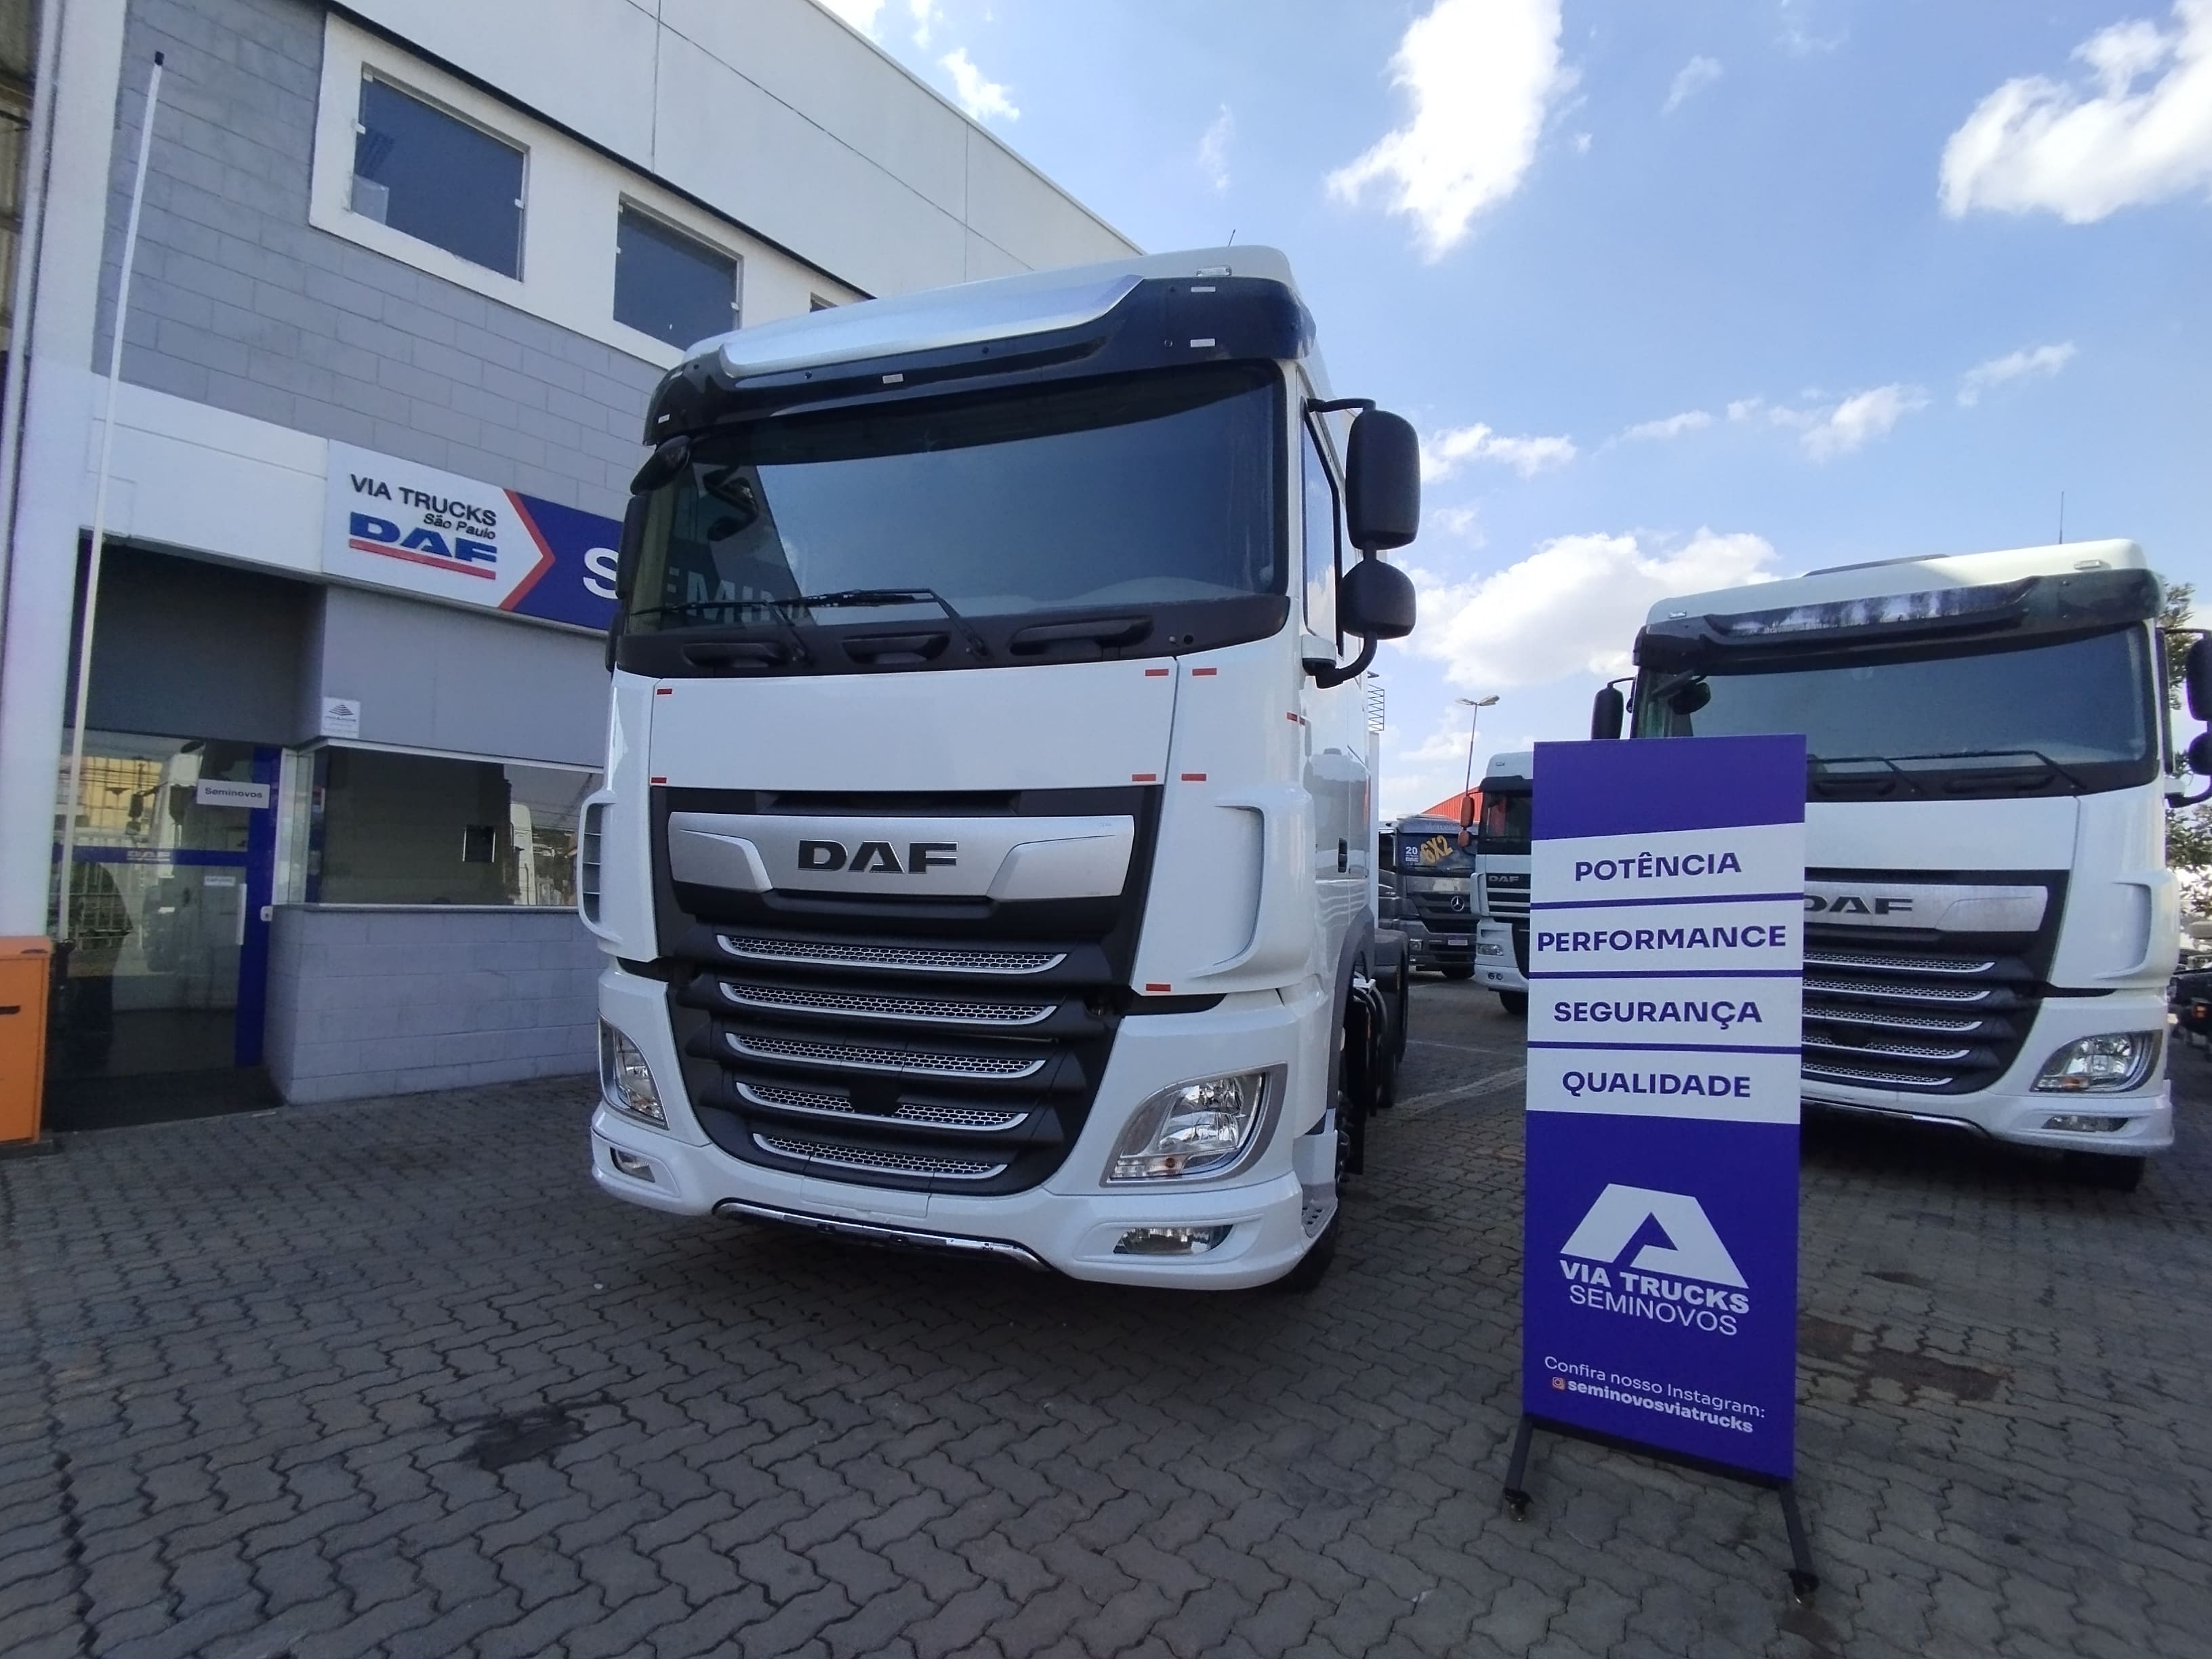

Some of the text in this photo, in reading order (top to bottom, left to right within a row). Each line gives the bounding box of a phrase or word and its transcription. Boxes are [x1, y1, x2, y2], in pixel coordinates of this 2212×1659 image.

[350, 474, 497, 527] VIA TRUCKS
[350, 512, 497, 562] DAF
[424, 513, 496, 539] São Paulo
[205, 787, 263, 799] Seminovos
[798, 840, 958, 874] DAF
[1405, 846, 1418, 855] 20
[1488, 875, 1519, 883] DAF
[1575, 852, 1742, 881] POTÊNCIA
[1804, 895, 1913, 915] DAF
[1538, 925, 1786, 951] PERFORMANCE
[1554, 1001, 1762, 1030] SEGURANÇA
[1562, 1071, 1750, 1097] QUALIDADE
[1559, 1259, 1750, 1314] VIA TRUCKS
[1570, 1284, 1738, 1336] SEMINOVOS
[1544, 1356, 1765, 1418] Confira nosso Instagram:
[1568, 1379, 1753, 1433] seminovosviatrucks
